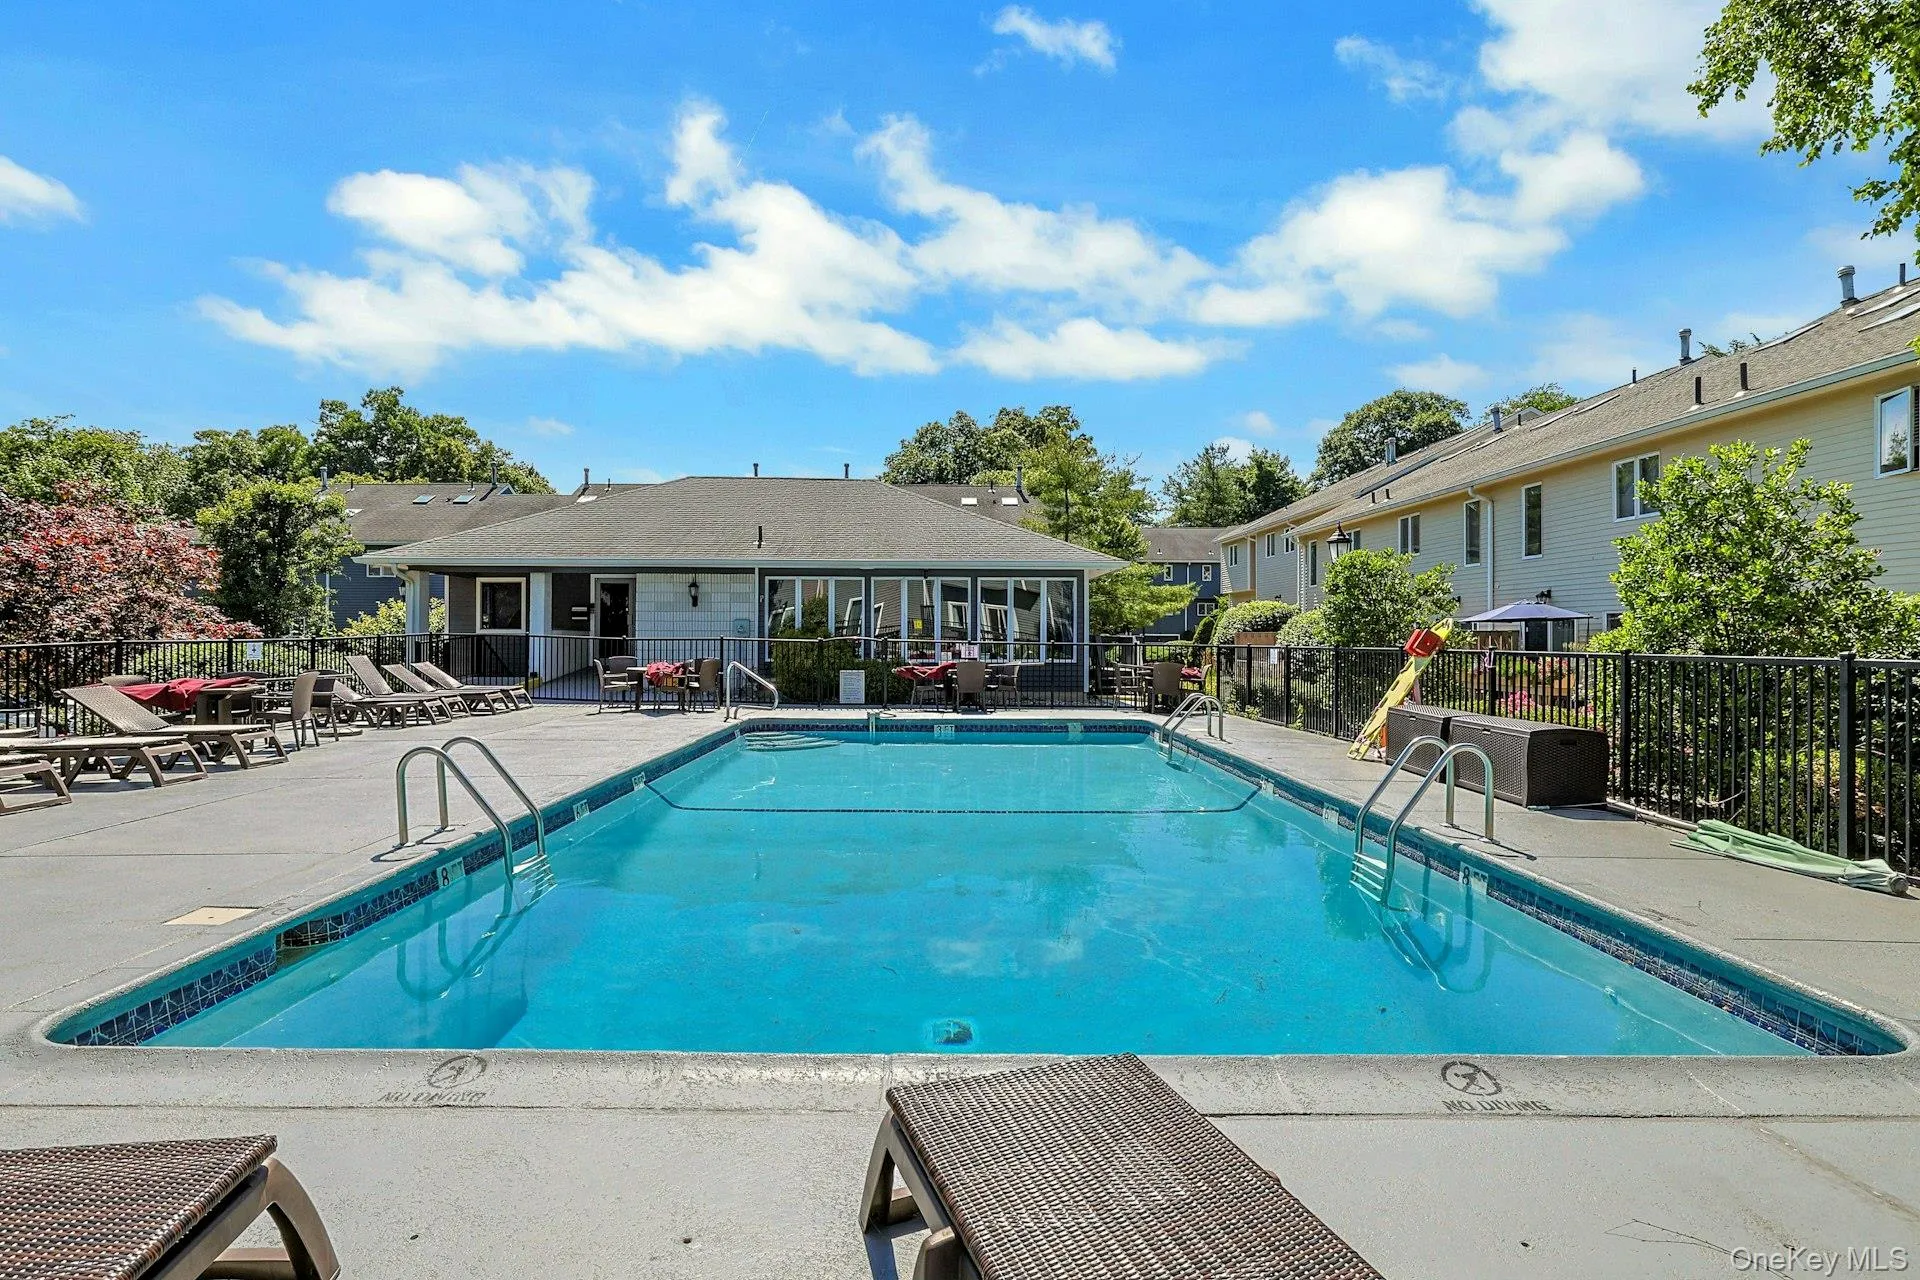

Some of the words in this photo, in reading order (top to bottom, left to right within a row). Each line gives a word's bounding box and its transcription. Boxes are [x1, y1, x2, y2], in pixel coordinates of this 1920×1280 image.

[441, 867, 450, 886] 8
[1462, 866, 1470, 885] 8
[1441, 1100, 1476, 1112] NO
[1477, 1100, 1553, 1112] DIVING
